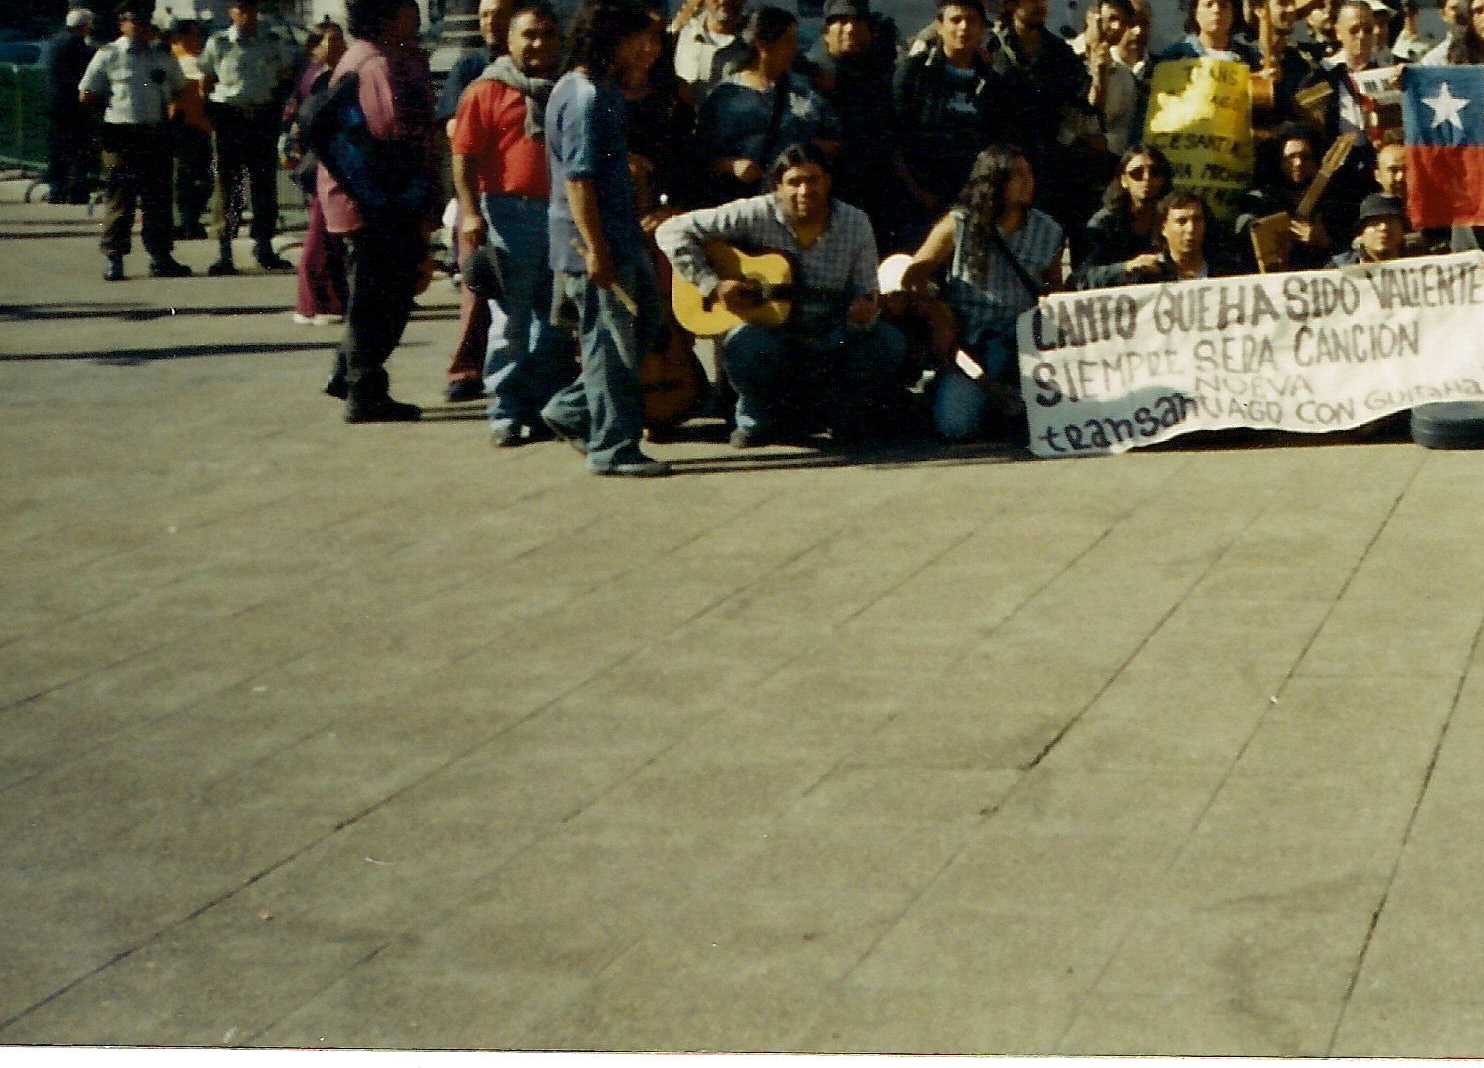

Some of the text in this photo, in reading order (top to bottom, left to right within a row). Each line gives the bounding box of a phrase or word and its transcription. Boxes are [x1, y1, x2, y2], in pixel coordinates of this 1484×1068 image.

[1032, 294, 1138, 352] CANTO
[1282, 275, 1361, 323] SIDO
[1194, 334, 1278, 374] SERA
[1195, 374, 1315, 398] NUEVA
[1296, 396, 1357, 425] CON
